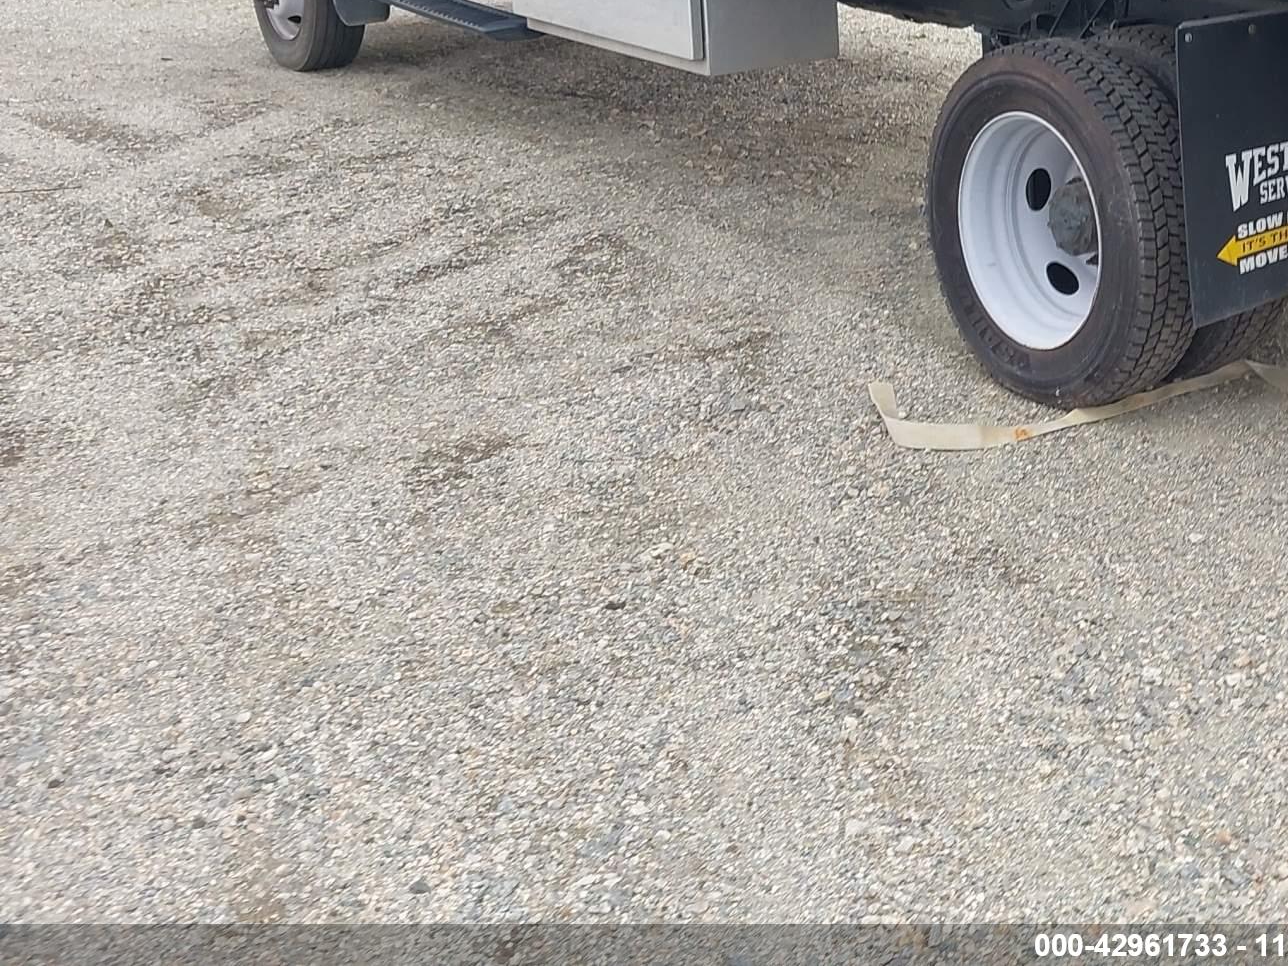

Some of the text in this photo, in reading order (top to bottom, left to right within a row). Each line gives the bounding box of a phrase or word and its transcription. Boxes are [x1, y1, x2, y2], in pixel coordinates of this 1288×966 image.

[1237, 209, 1284, 240] SLOW
[1239, 244, 1288, 275] MOVE
[1241, 236, 1266, 254] IT'S
